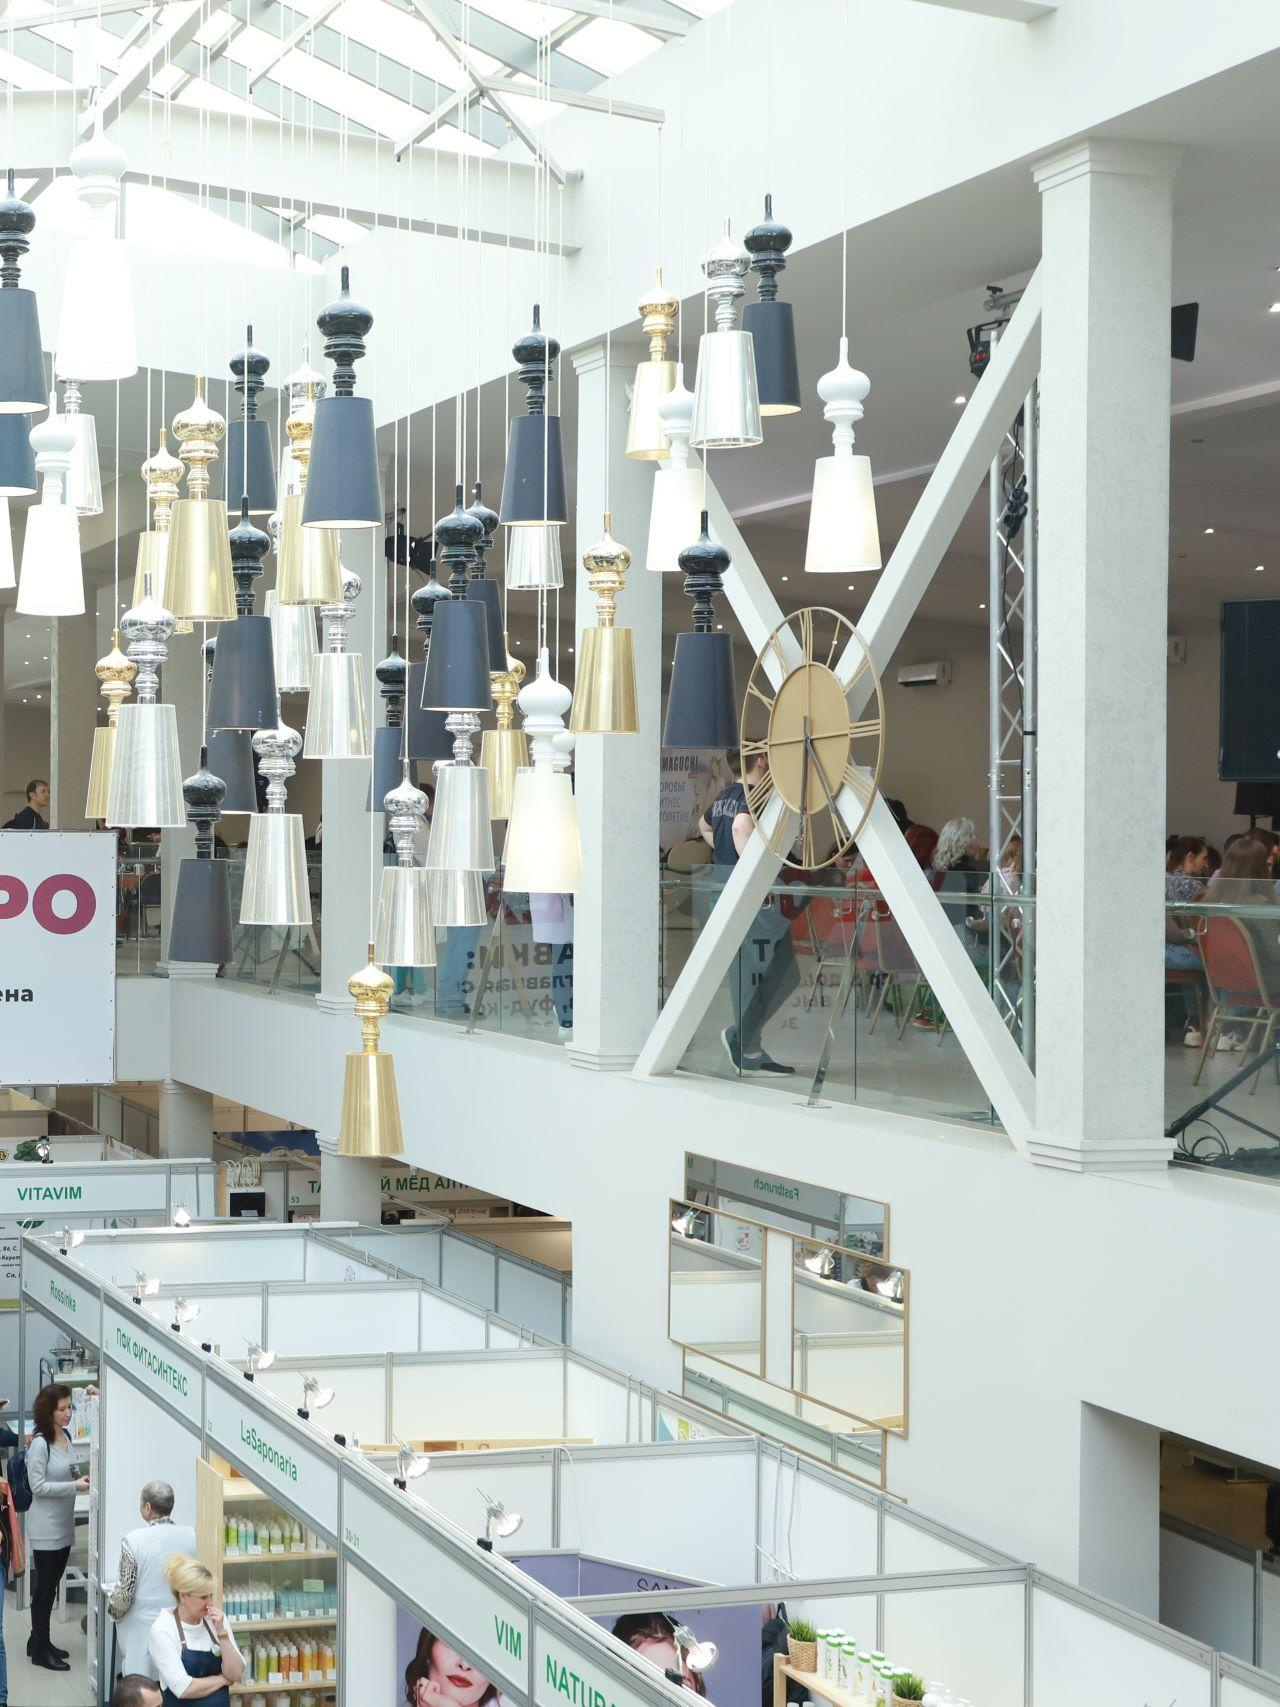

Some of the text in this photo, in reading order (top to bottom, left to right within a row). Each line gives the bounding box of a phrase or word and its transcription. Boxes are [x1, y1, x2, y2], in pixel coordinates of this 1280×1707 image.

[660, 756, 698, 771] MAGUCHI
[660, 782, 685, 792] ОРОВЬЕ
[17, 1186, 82, 1201] VITAVIM
[396, 1175, 430, 1192] МЁД
[50, 1280, 76, 1312] Rossinka
[116, 1327, 188, 1397] ПФК ФИТАСИНТЕКС
[240, 1420, 298, 1482] LaSaponaria
[494, 1615, 616, 1707] VIM NATUR
